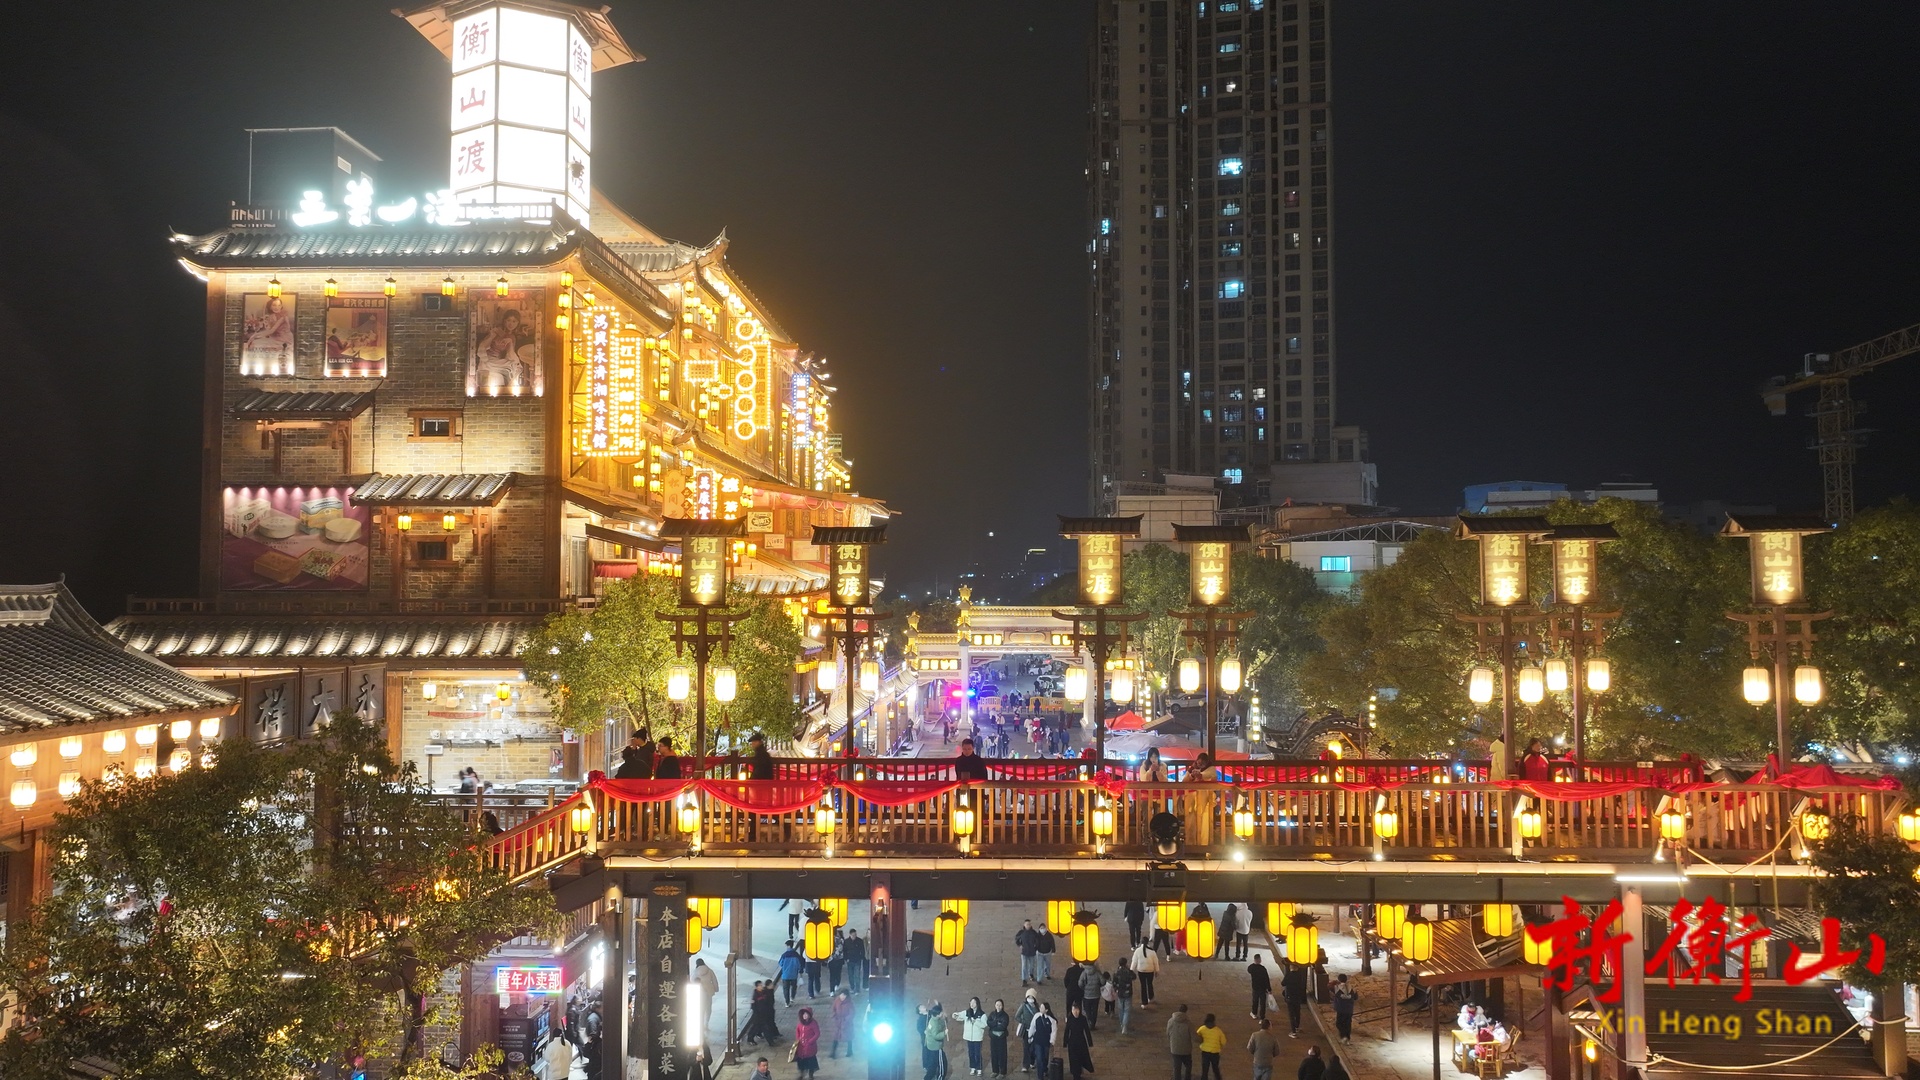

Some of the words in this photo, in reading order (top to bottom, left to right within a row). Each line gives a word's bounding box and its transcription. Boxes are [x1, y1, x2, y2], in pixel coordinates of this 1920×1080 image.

[457, 21, 490, 176] 衡山渡
[690, 537, 717, 595] 衡山渡
[837, 544, 862, 597] 衡山渡
[1086, 534, 1116, 595] 衡山渡
[1199, 542, 1226, 596] 衡山渡
[1491, 534, 1521, 599] 衡山渡
[1562, 540, 1590, 596] 衡山渡
[1761, 532, 1795, 593] 衡山渡
[500, 971, 560, 990] 童年小卖部
[657, 906, 678, 1075] 本店自運各種菜
